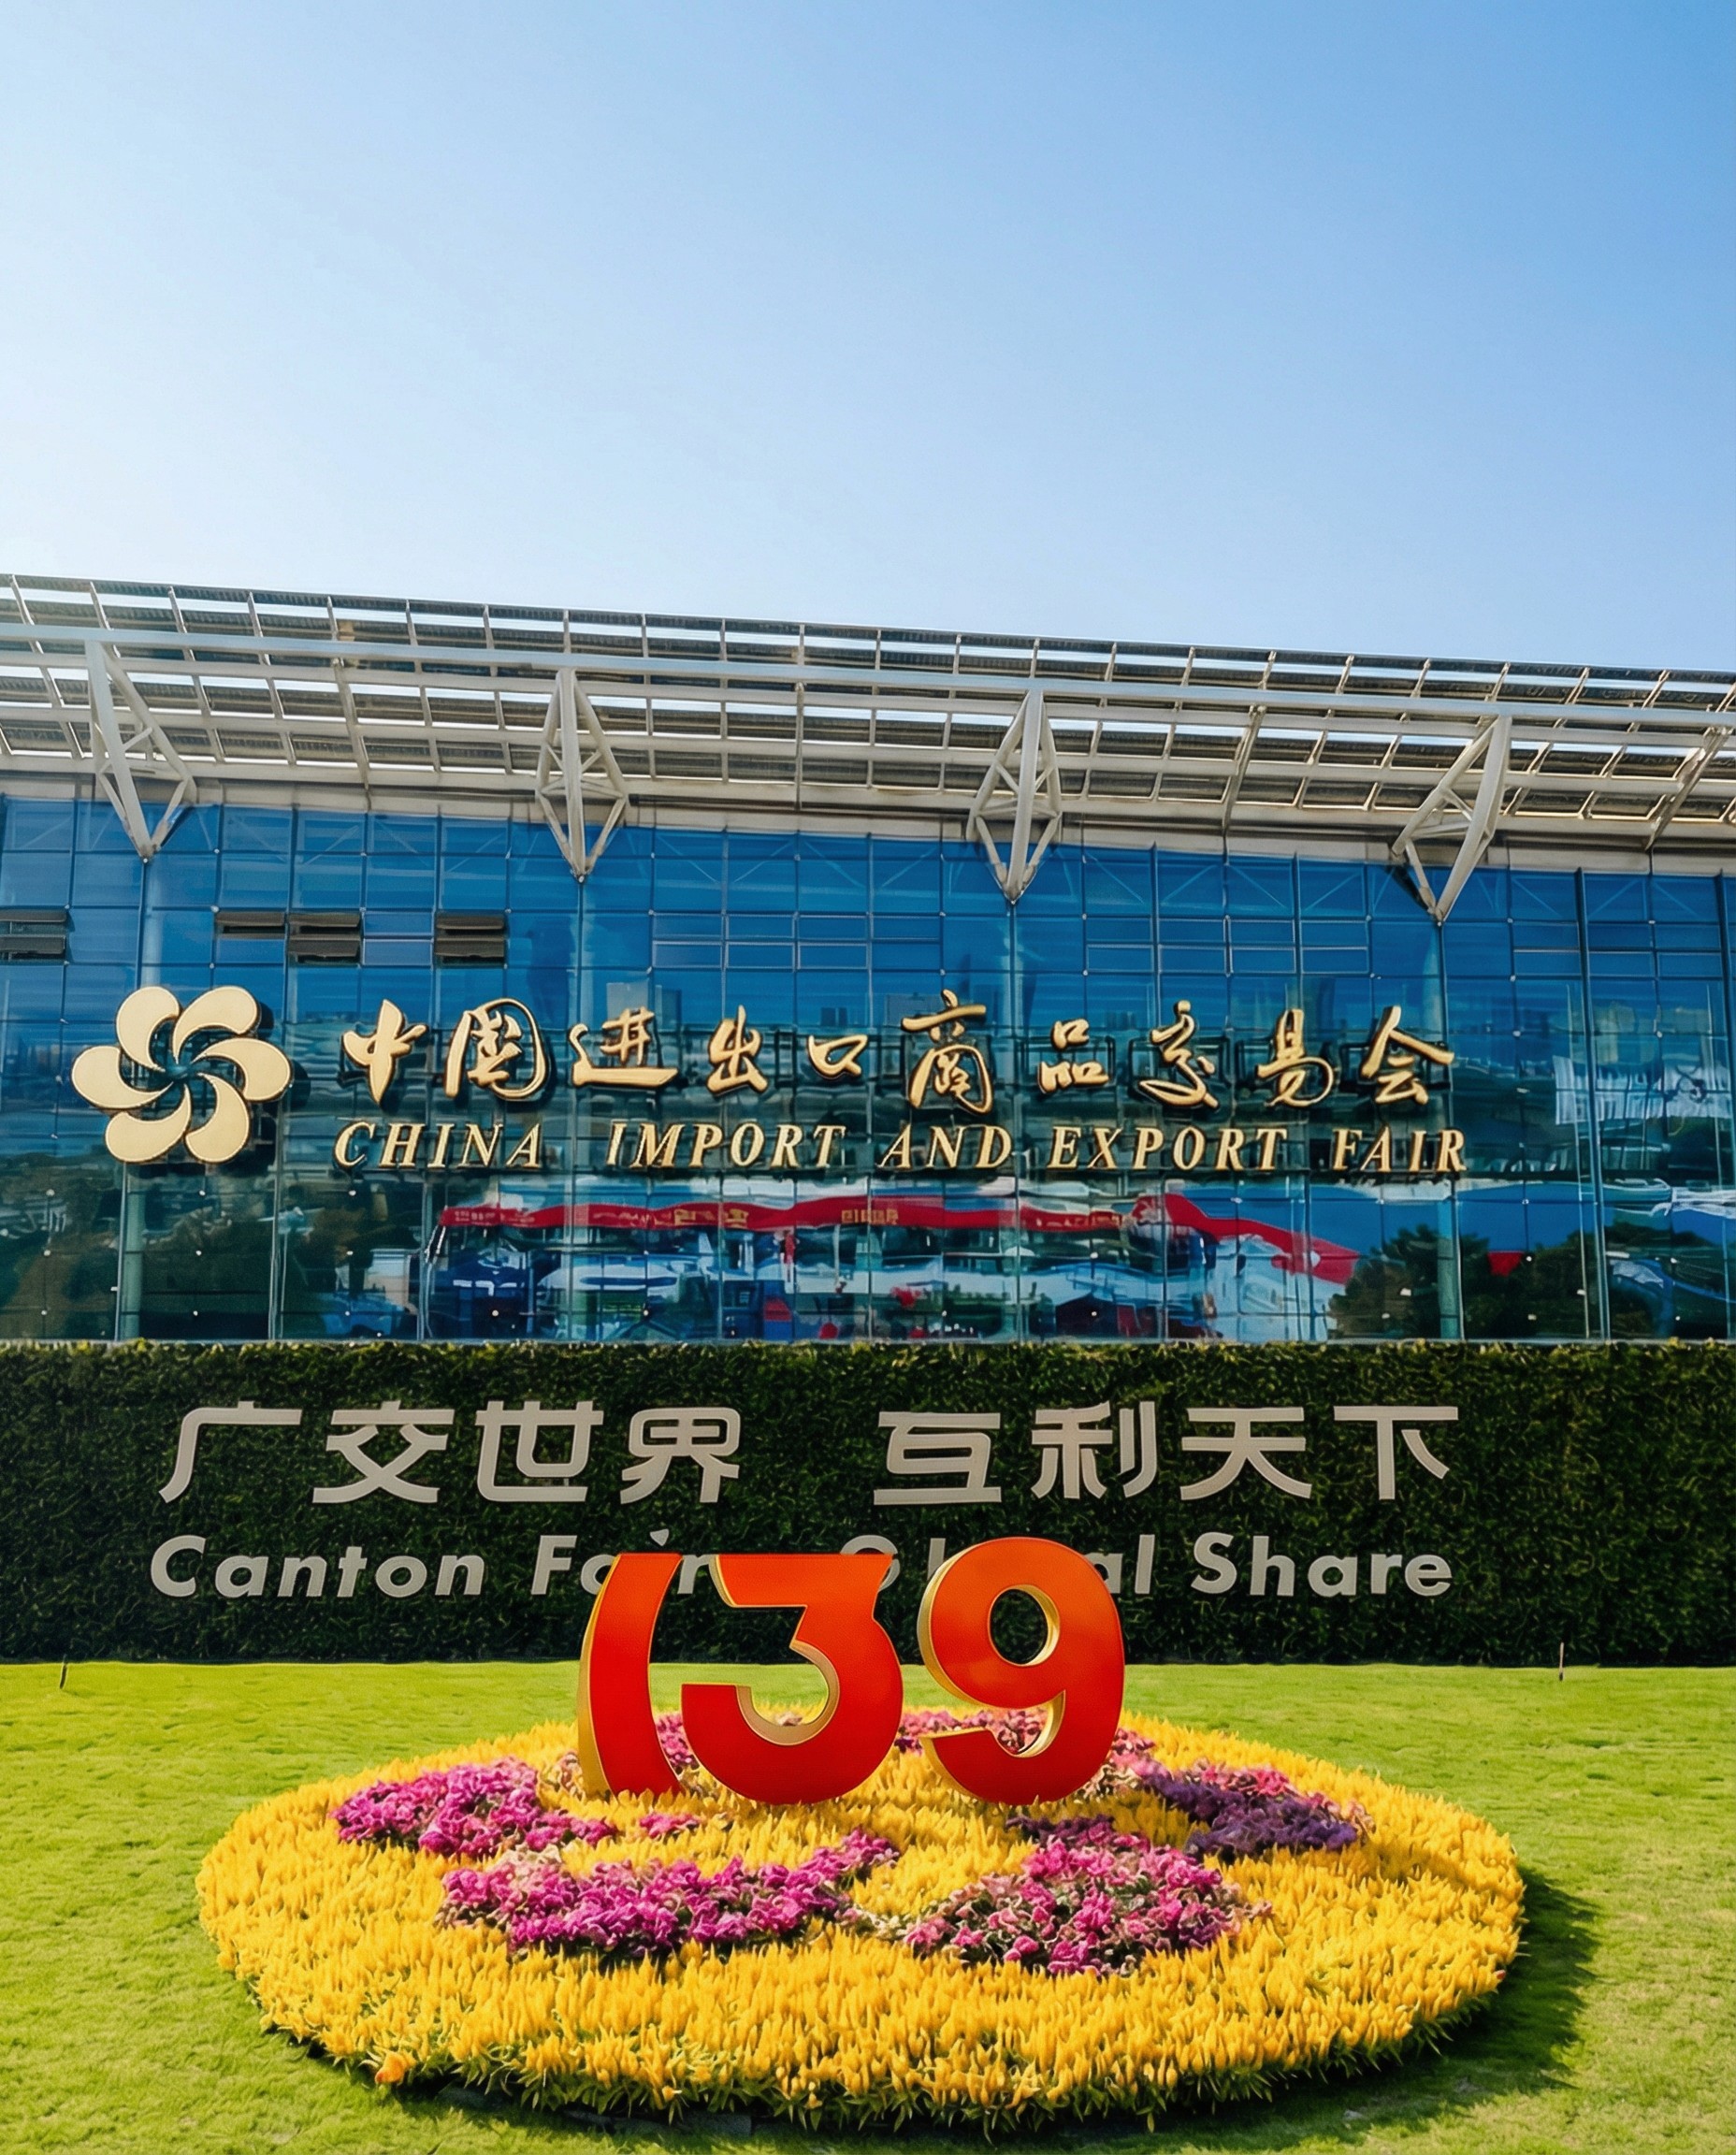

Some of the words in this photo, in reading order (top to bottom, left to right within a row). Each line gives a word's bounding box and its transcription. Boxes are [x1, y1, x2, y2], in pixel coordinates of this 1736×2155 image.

[334, 1121, 544, 1170] CHINA
[605, 1122, 849, 1170] IMPORT
[877, 1124, 1013, 1171] AND
[1049, 1126, 1290, 1173] EXPORT
[1332, 1127, 1469, 1175] FAIR
[158, 1399, 742, 1505] 广交世界
[873, 1399, 1460, 1507] 互利天下
[150, 1534, 485, 1598] Canton
[530, 1528, 717, 1596] Fr
[1190, 1531, 1454, 1598] Share
[577, 1536, 1125, 1805] 139
